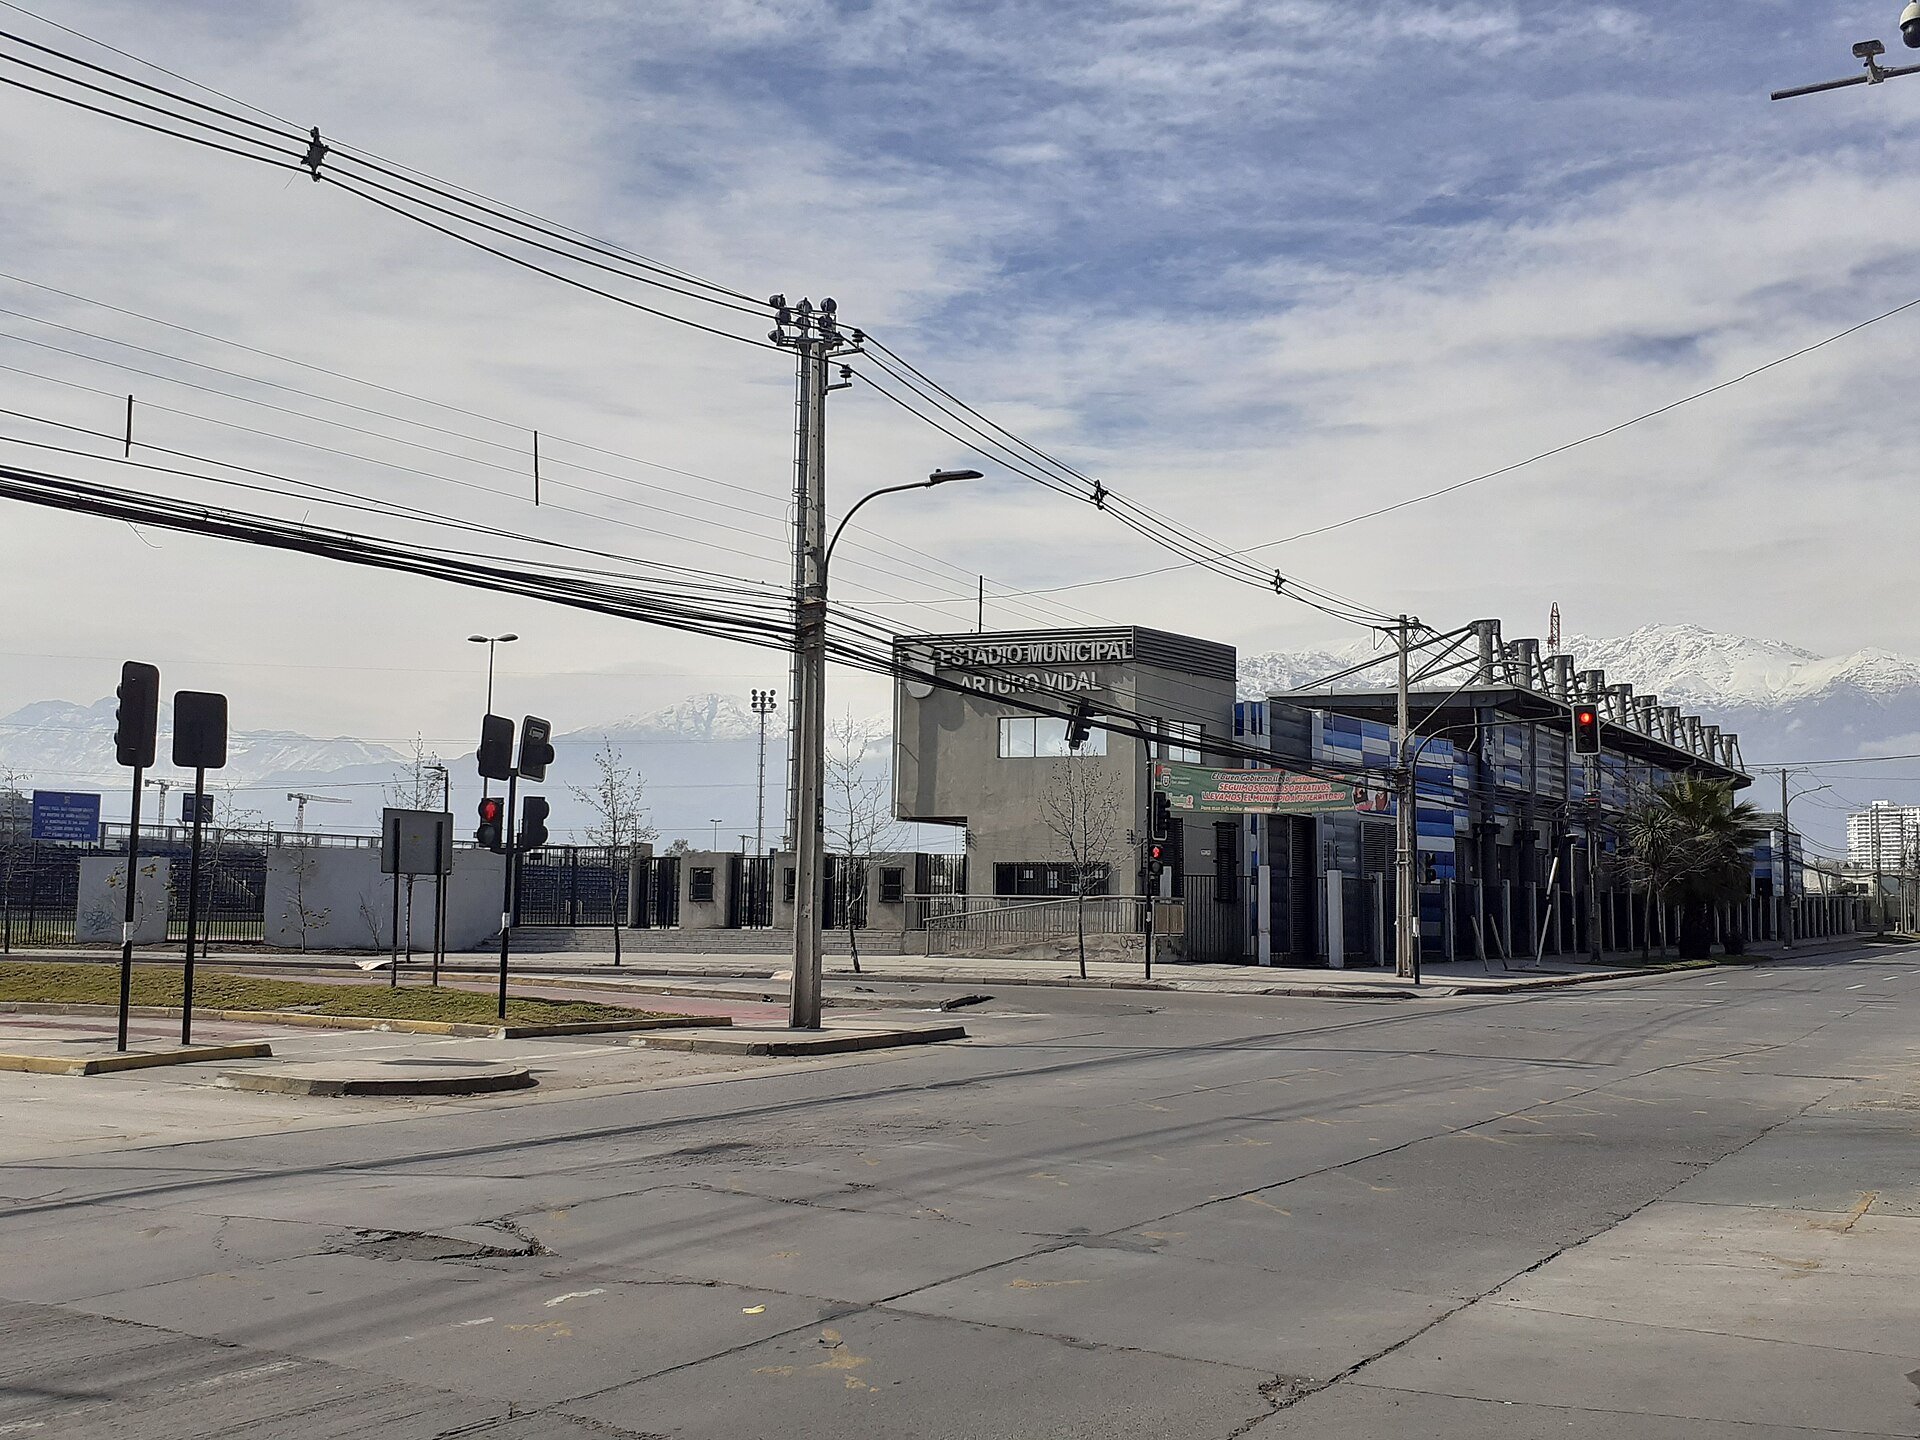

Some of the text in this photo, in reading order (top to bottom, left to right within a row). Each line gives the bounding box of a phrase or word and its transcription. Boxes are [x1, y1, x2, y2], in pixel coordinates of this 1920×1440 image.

[939, 640, 1134, 666] ESTADIO MUNICIPAL
[959, 671, 1103, 695] ARTURO VIDAL
[1201, 791, 1242, 801] LLEVAMOS
[1243, 793, 1253, 802] EL
[1253, 794, 1291, 802] MUNICIPIO
[1296, 793, 1306, 802] TU
[1305, 791, 1346, 802] TERRITORIO
[1218, 783, 1259, 793] SEGUIMOS
[1259, 784, 1275, 793] CON
[1275, 784, 1290, 793] LOS
